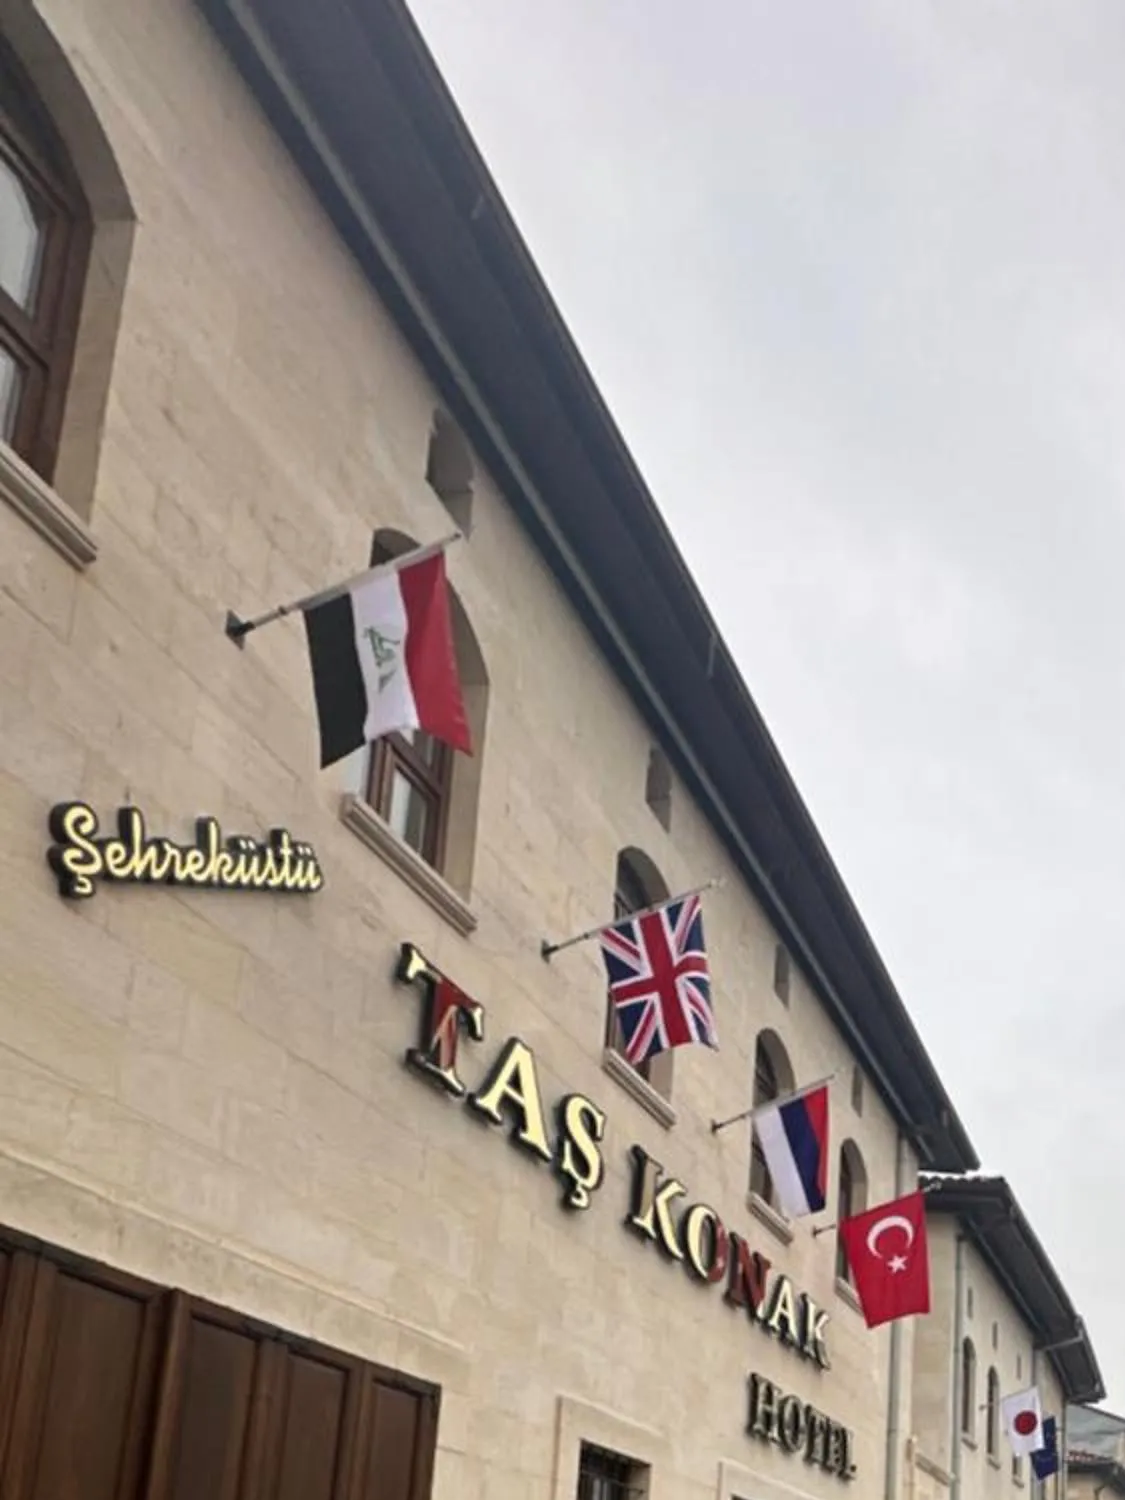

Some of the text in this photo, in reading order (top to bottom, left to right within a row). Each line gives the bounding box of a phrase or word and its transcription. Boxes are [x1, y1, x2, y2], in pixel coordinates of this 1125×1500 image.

[52, 802, 322, 895] Şehreküstü
[400, 943, 831, 1370] TAŞ KONAK
[747, 1372, 856, 1482] HOTEL
